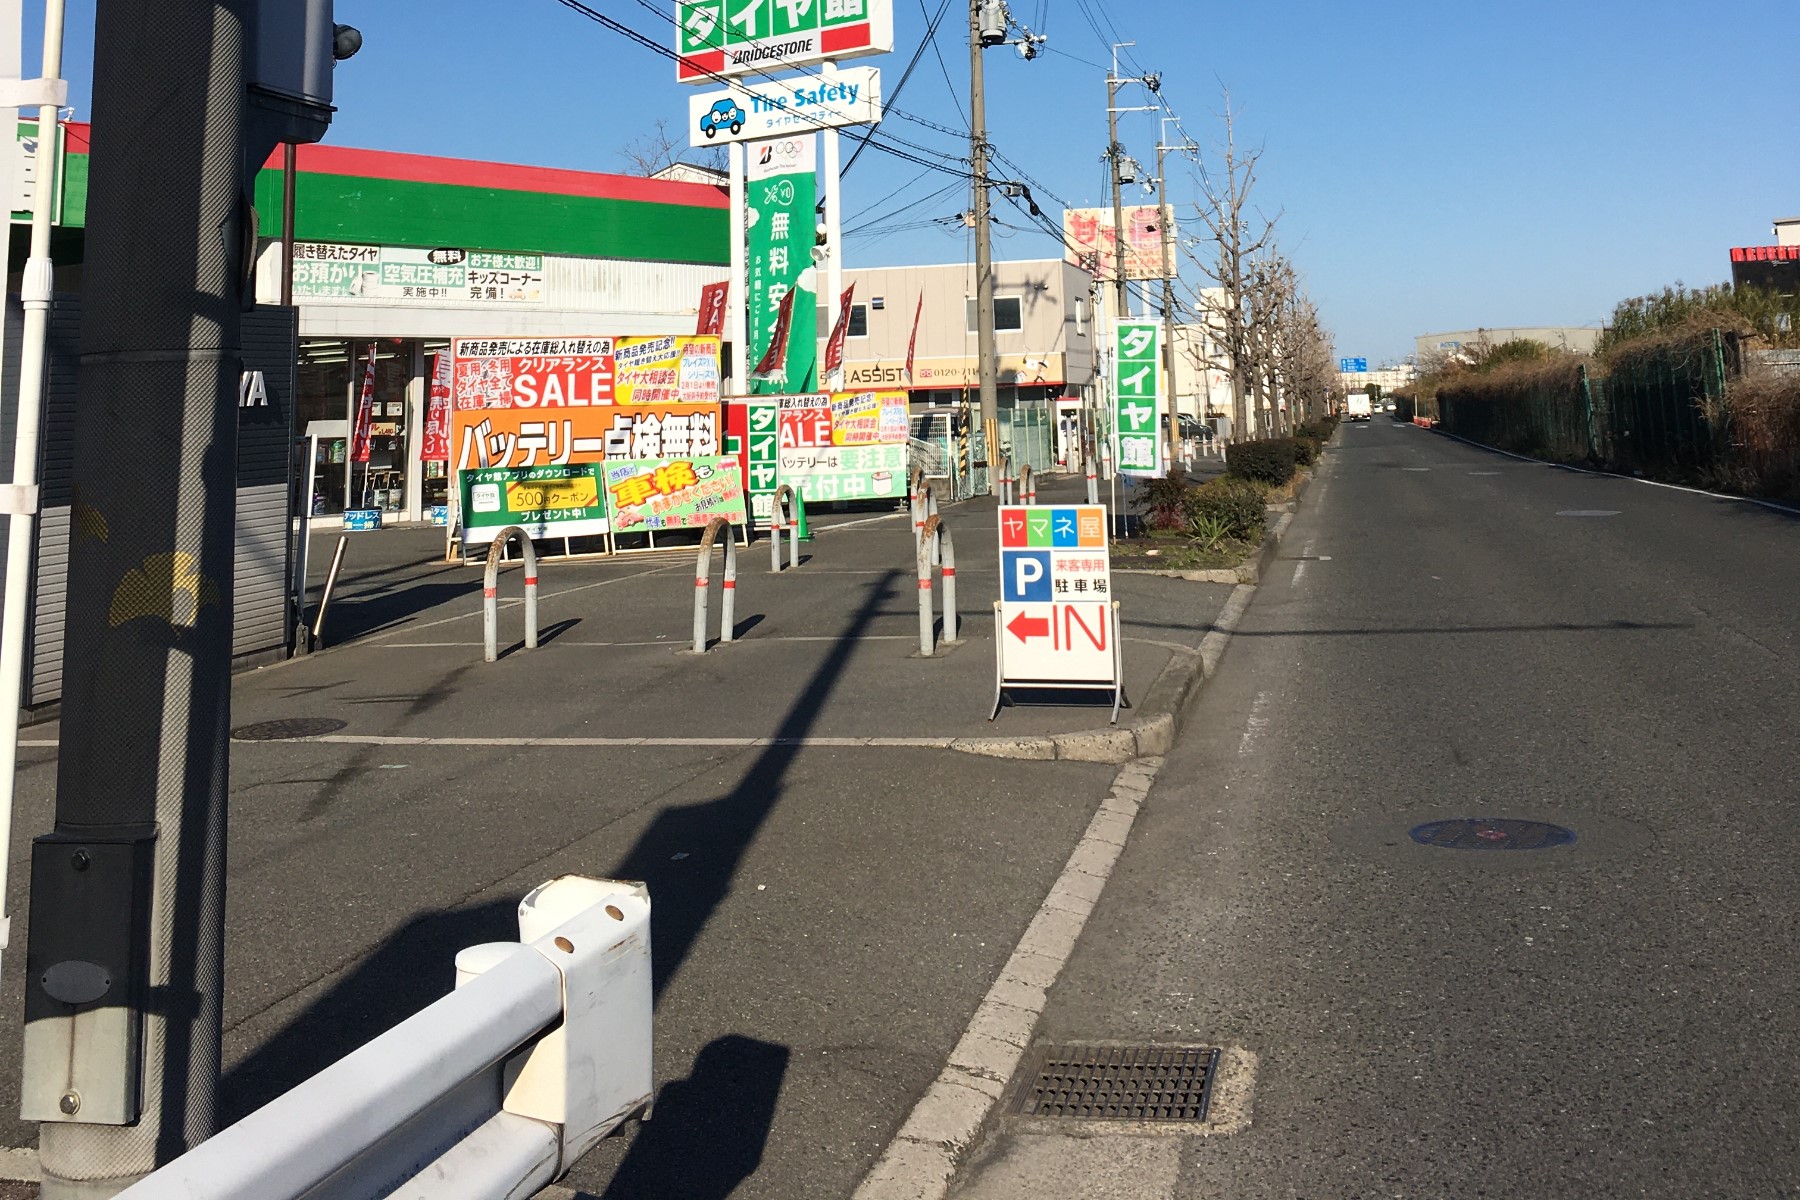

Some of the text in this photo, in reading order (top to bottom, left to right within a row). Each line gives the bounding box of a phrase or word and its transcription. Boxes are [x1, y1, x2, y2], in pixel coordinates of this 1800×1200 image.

[733, 39, 812, 64] BRIDGESTONE
[751, 82, 859, 113] Tire Safety
[293, 244, 378, 261] 履き替えたタイヤ
[433, 251, 461, 264] 無料
[384, 265, 464, 286] 空気圧補充
[468, 270, 542, 286] キッズコーナー
[518, 356, 606, 373] クリアランス
[617, 369, 677, 385] タイヤ大相談会
[850, 368, 904, 383] ASSIST
[514, 373, 613, 408] SALE
[632, 388, 680, 402] 同時開催中
[1121, 328, 1154, 468] タイヤ館
[458, 411, 718, 469] バッテリー点検無料
[751, 407, 776, 517] タイヤ館
[516, 492, 589, 506] 500円クーポン
[1003, 516, 1101, 539] ヤマネ屋
[1056, 559, 1105, 572] 来客専用
[1016, 557, 1044, 596] P
[1055, 578, 1107, 593] 駐車場
[1053, 605, 1106, 651] IN
